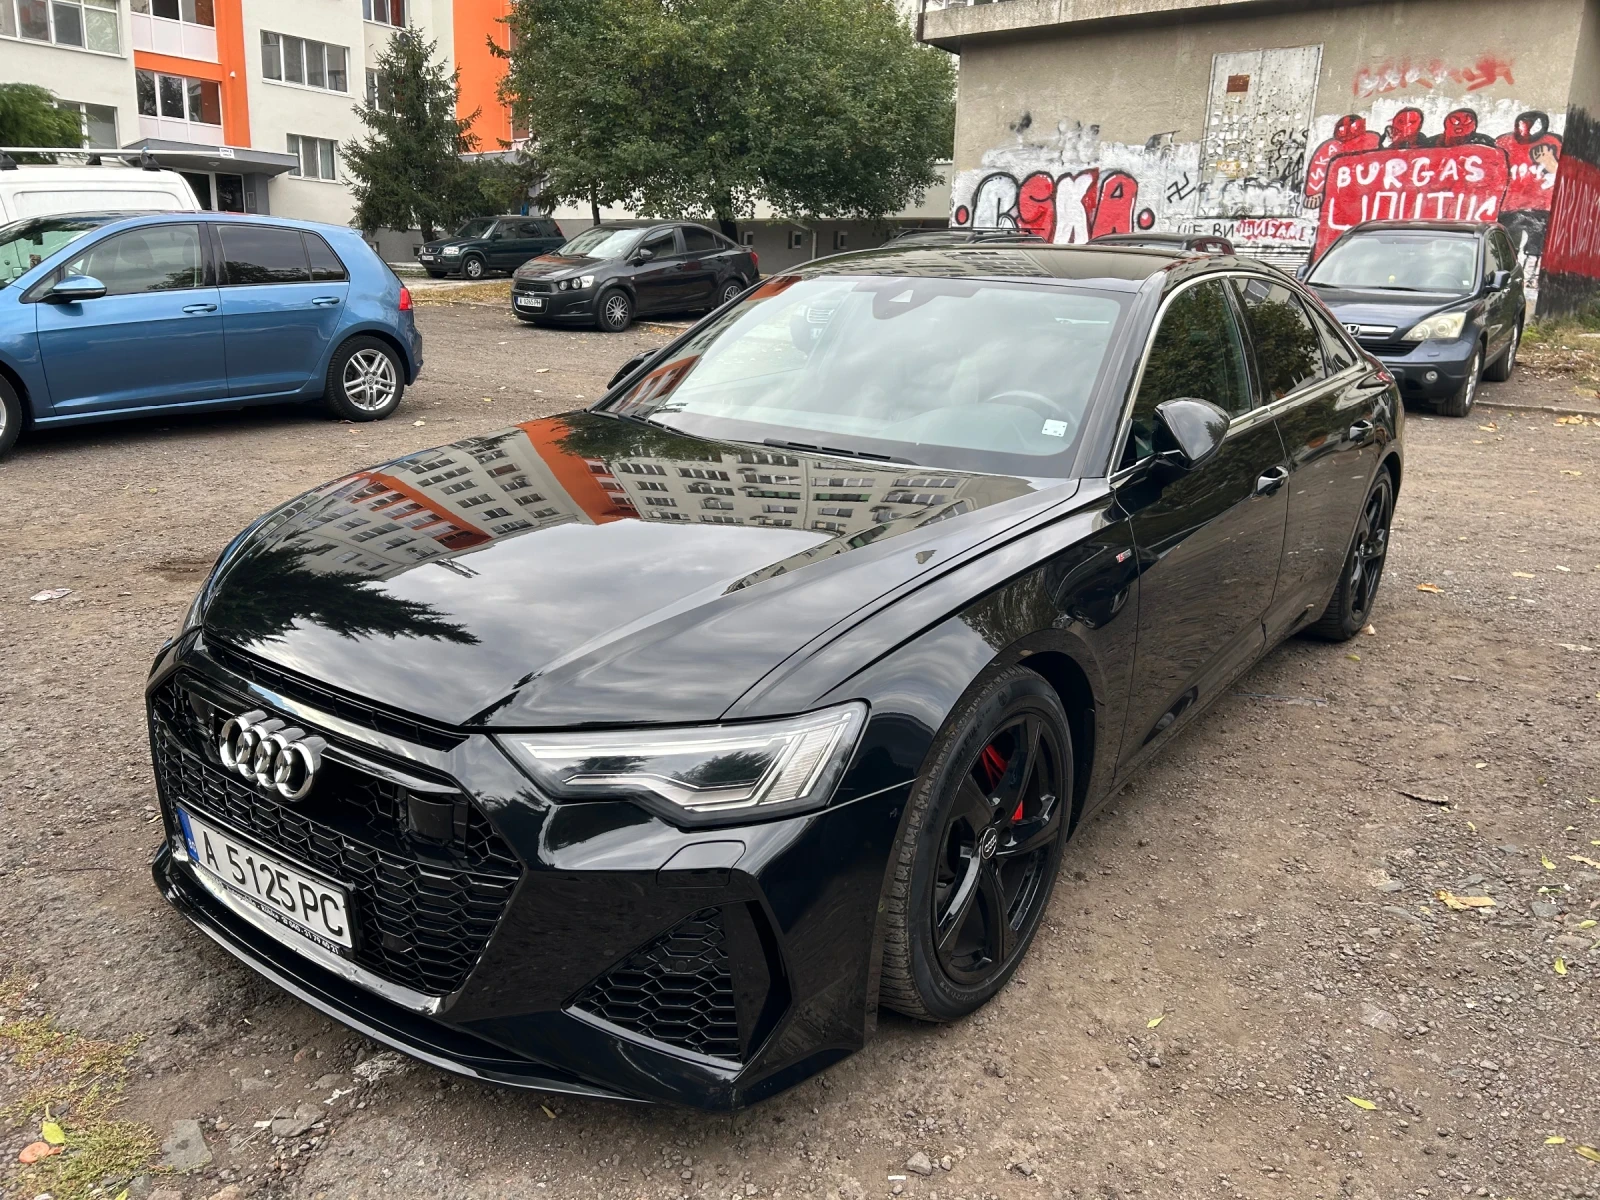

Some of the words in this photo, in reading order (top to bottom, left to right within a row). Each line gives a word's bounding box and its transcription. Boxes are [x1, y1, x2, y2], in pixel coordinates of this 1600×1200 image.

[1337, 155, 1485, 190] BURGAS
[1212, 222, 1235, 238] ВИ
[203, 830, 220, 871] A
